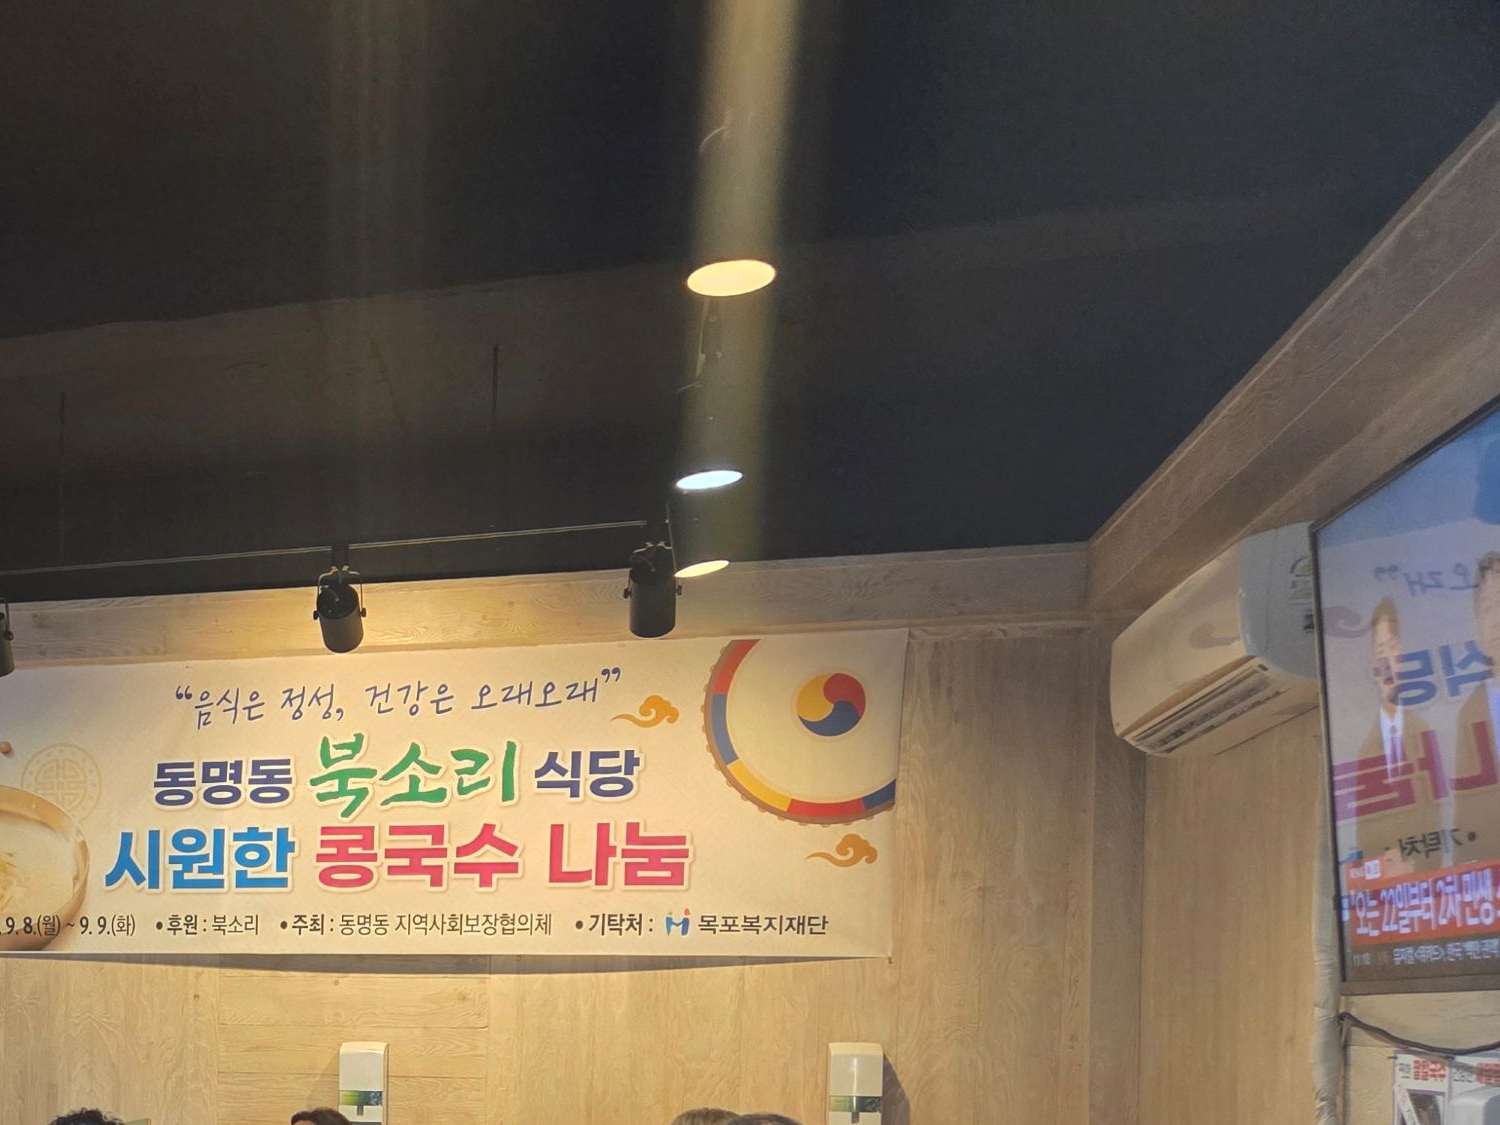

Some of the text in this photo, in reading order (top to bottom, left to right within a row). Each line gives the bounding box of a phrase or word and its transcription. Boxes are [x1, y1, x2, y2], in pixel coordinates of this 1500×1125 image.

[175, 667, 621, 730] “음식은 정성, 건강은 오래오래”
[153, 731, 641, 819] 동명동 북소리 식당
[104, 820, 688, 890] 시원한 콩국수 나눔
[167, 914, 198, 936] 후원
[211, 914, 259, 936] 북소리
[292, 913, 325, 936] 주최
[339, 914, 389, 936] 동명동
[395, 913, 552, 936] 지역사회보장협의체
[588, 913, 642, 937] 기탁처
[698, 914, 828, 936] 목포복지재단
